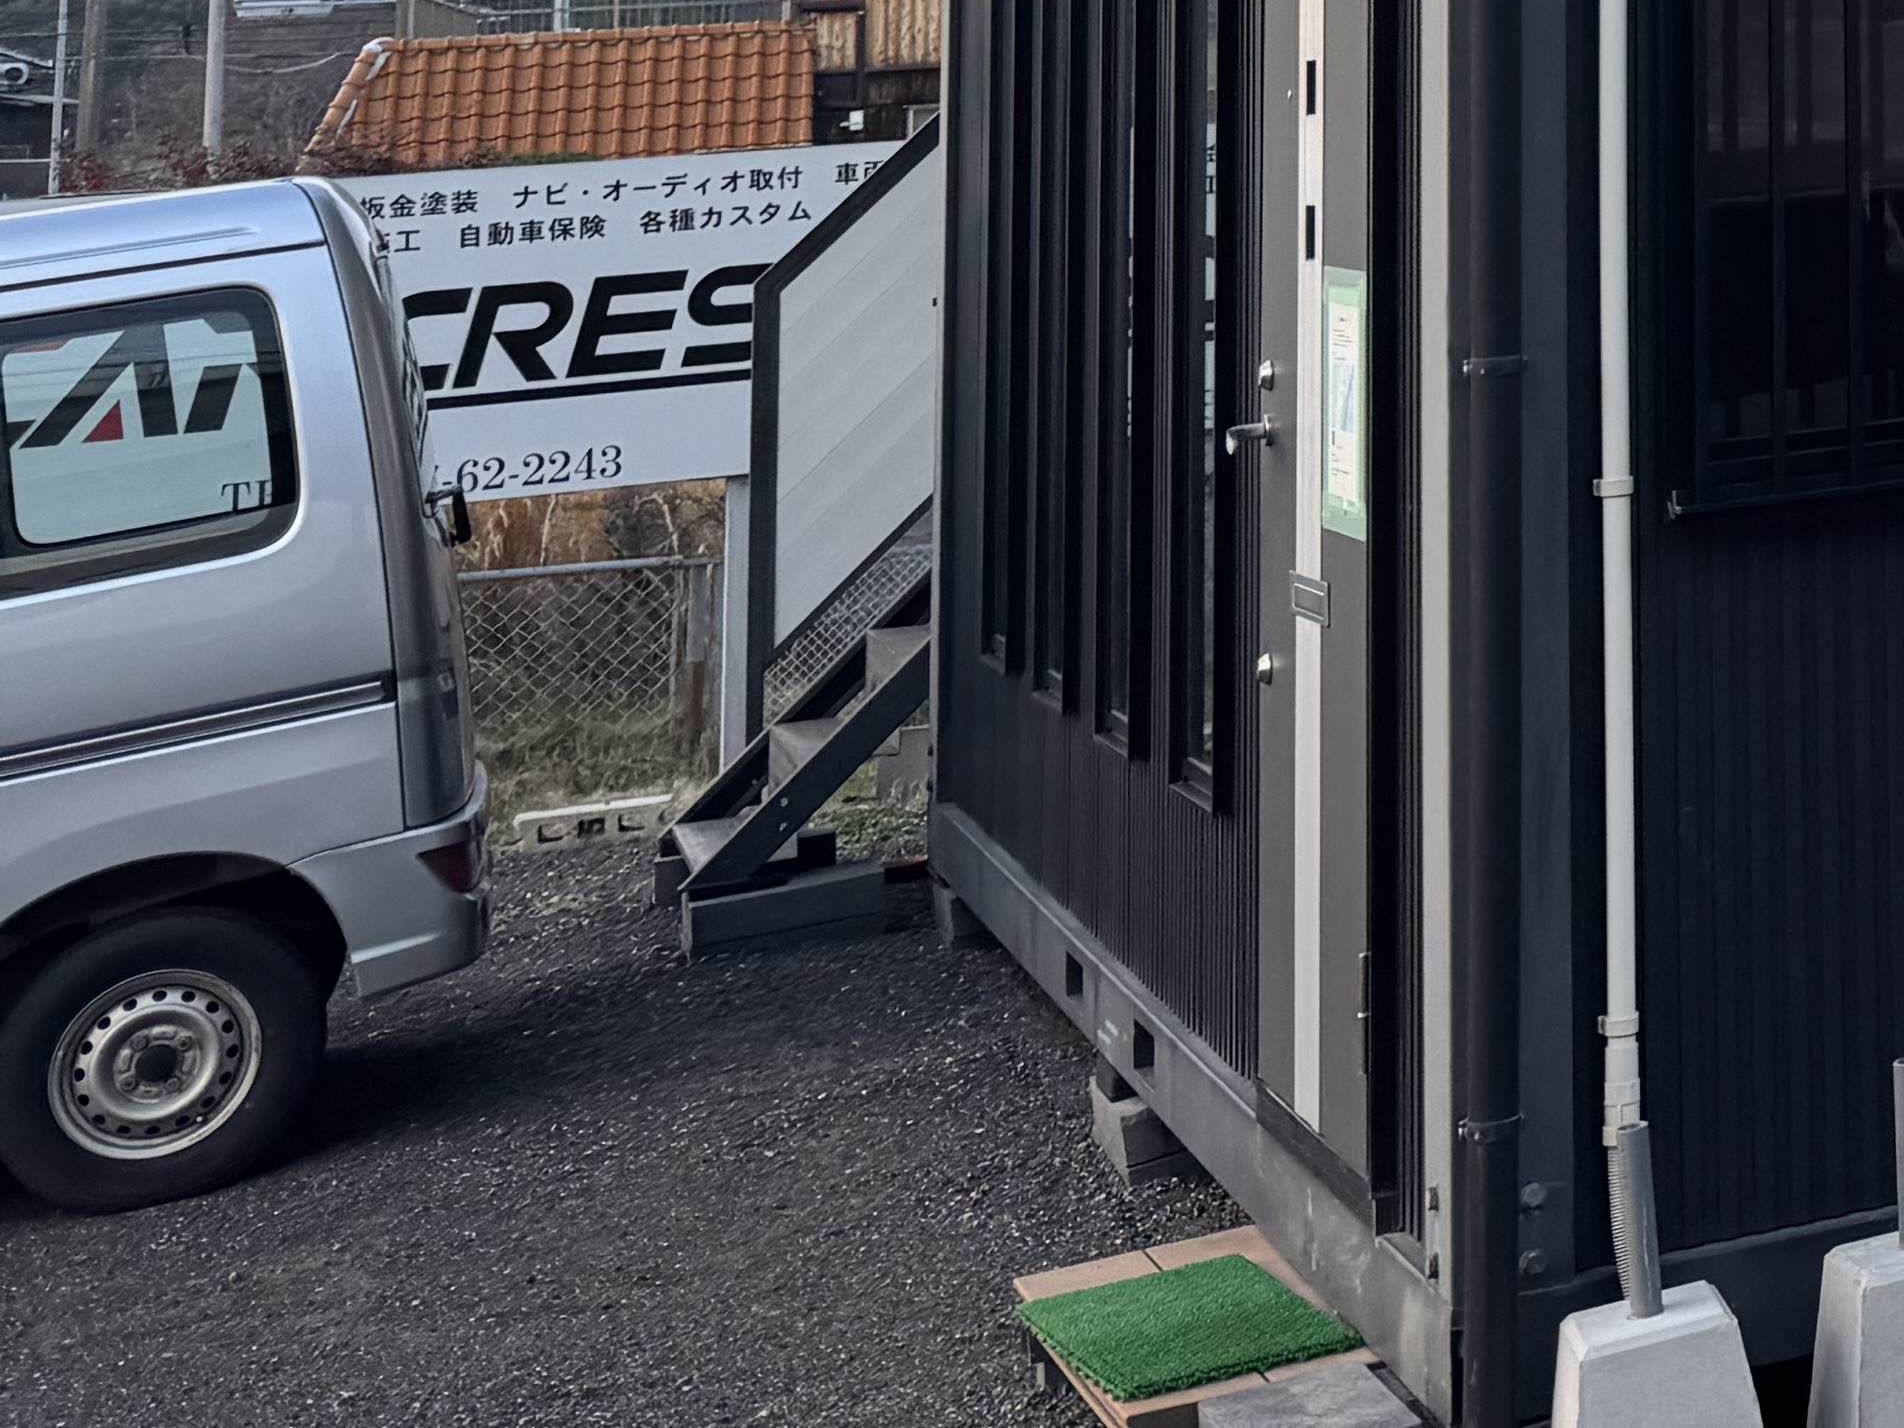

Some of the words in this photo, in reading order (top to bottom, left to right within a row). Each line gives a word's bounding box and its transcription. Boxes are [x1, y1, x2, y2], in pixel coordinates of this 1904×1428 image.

[460, 214, 608, 249] 自動車保険
[639, 199, 812, 235] 各種カスタム
